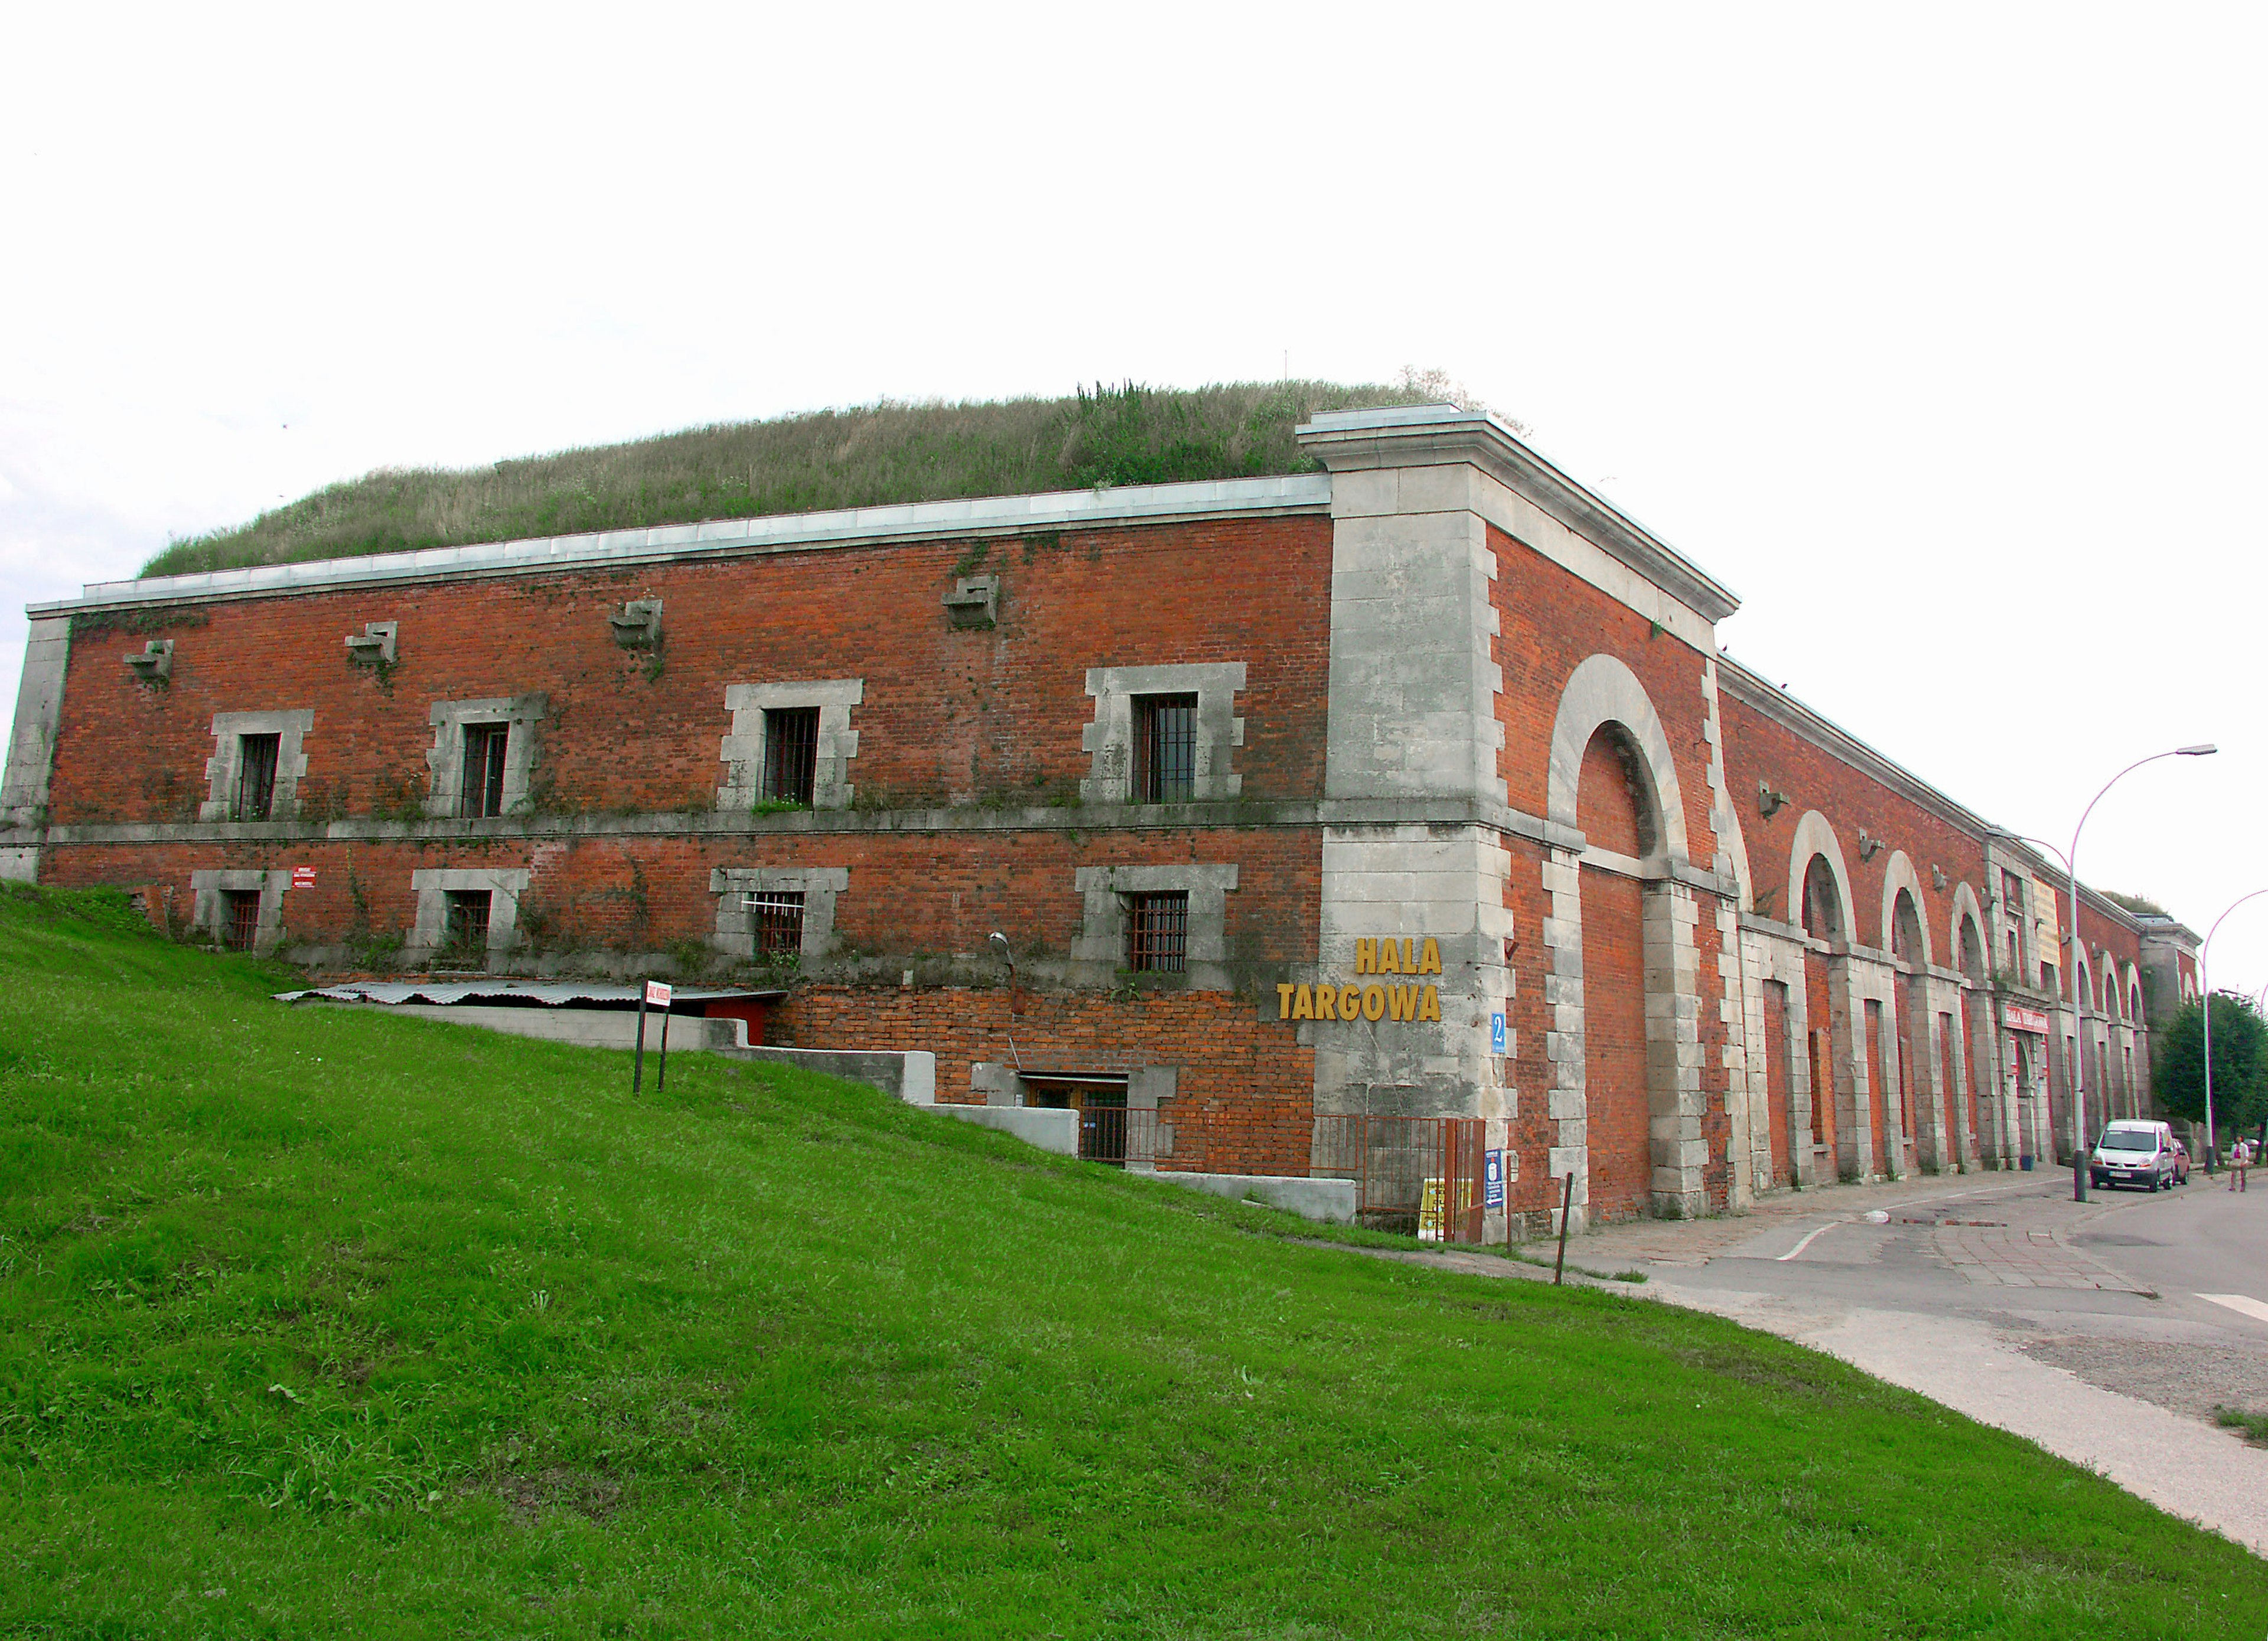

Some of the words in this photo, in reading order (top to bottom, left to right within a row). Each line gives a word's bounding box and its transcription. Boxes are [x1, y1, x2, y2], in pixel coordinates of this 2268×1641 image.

[1355, 937, 1442, 975] HALA
[1277, 983, 1441, 1022] TARGOWA
[2006, 1009, 2022, 1024] HALA
[1494, 1015, 1503, 1043] 2
